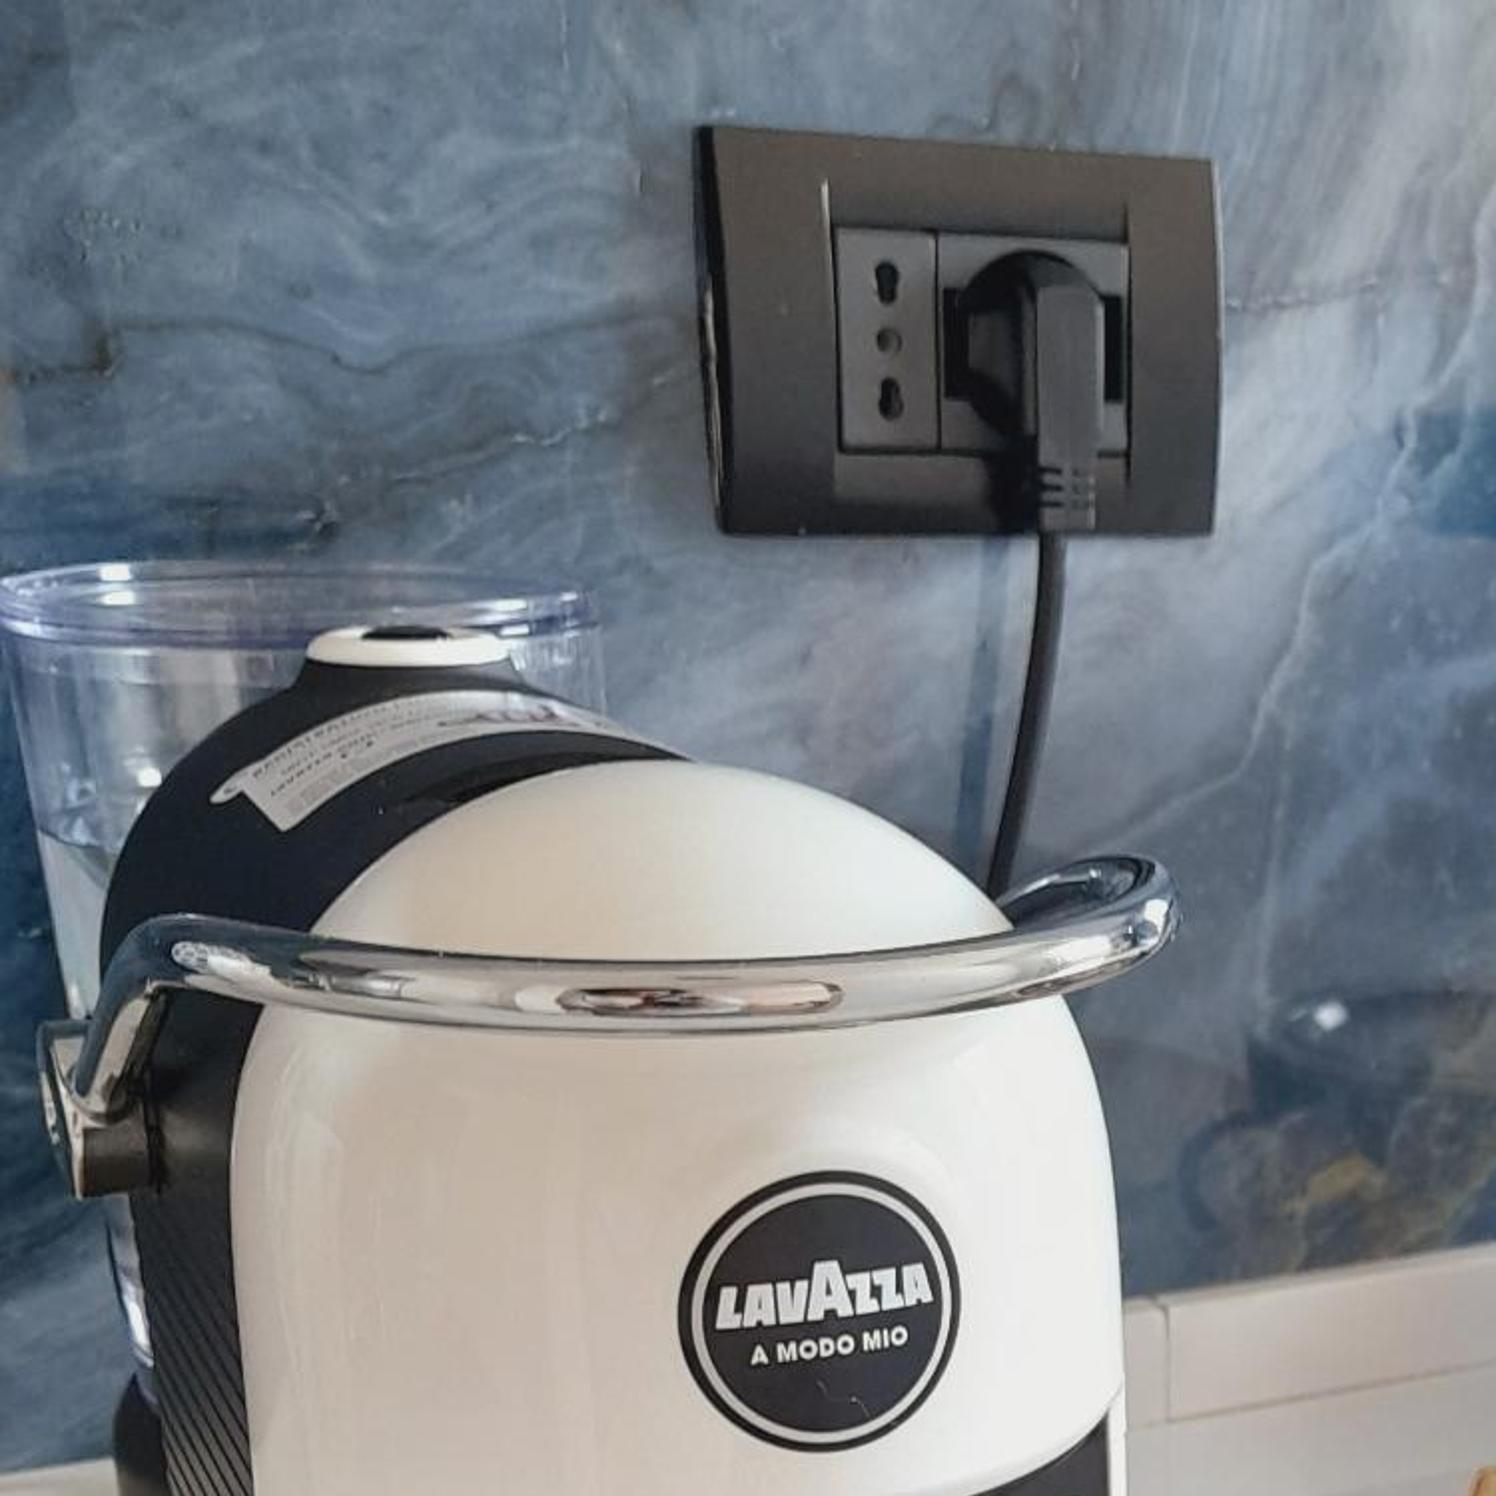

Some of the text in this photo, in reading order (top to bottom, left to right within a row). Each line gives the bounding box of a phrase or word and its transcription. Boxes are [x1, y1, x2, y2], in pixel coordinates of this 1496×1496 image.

[714, 1259, 934, 1330] LAVAZZA
[750, 1325, 909, 1366] A MODO MIO
